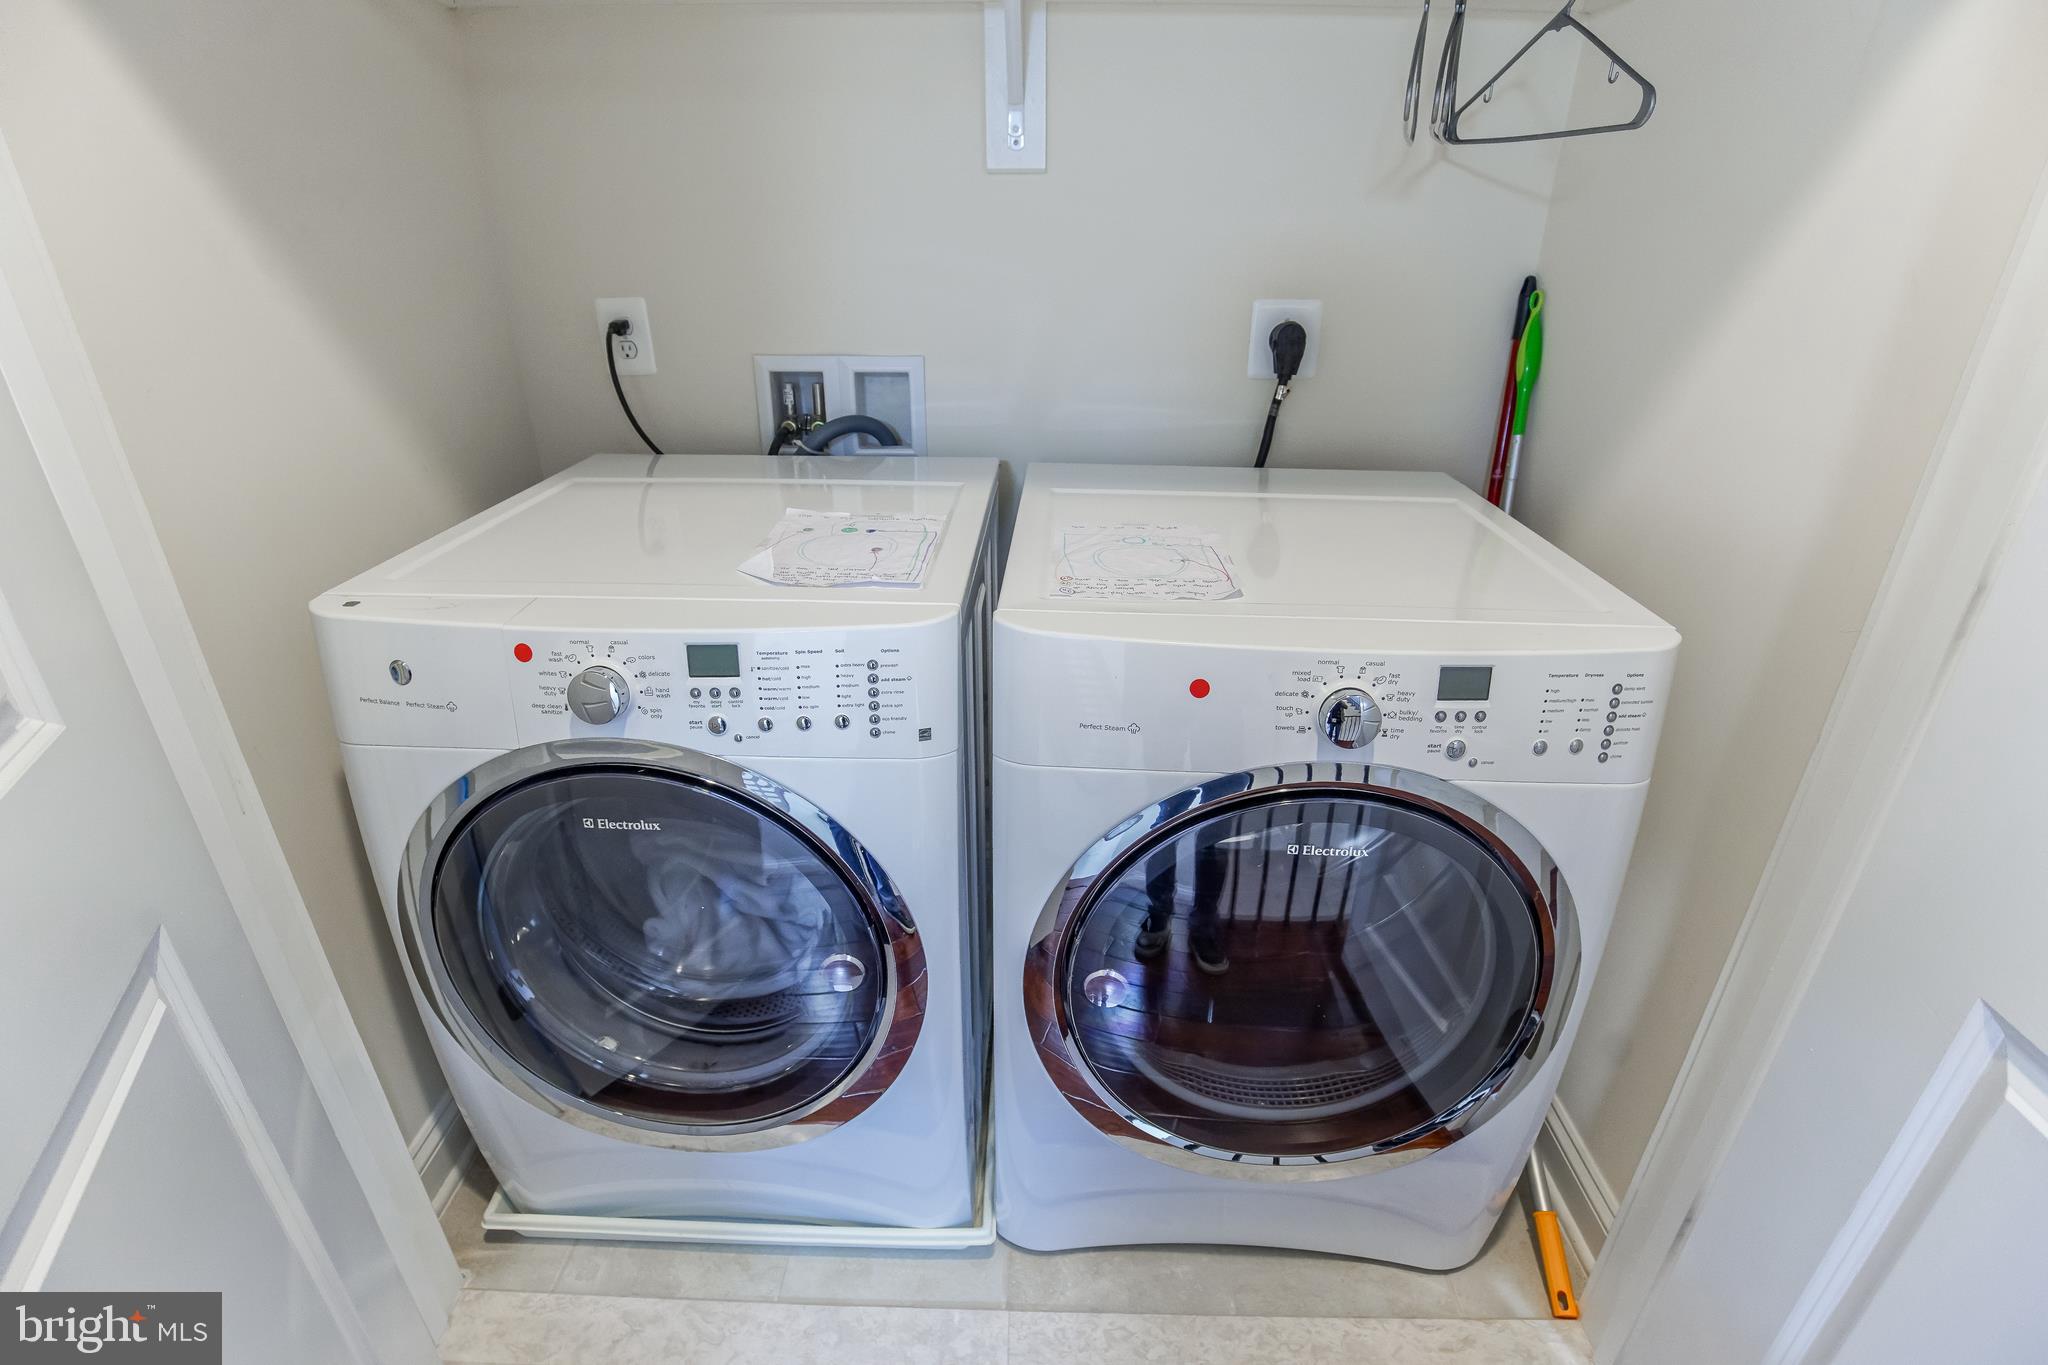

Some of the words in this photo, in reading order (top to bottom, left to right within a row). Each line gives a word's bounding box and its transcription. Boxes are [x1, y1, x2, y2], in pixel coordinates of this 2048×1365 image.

[1399, 709, 1419, 717] bulky/
[1104, 724, 1126, 732] Steam
[597, 818, 662, 831] Electrolux
[1302, 845, 1369, 857] Electrolux
